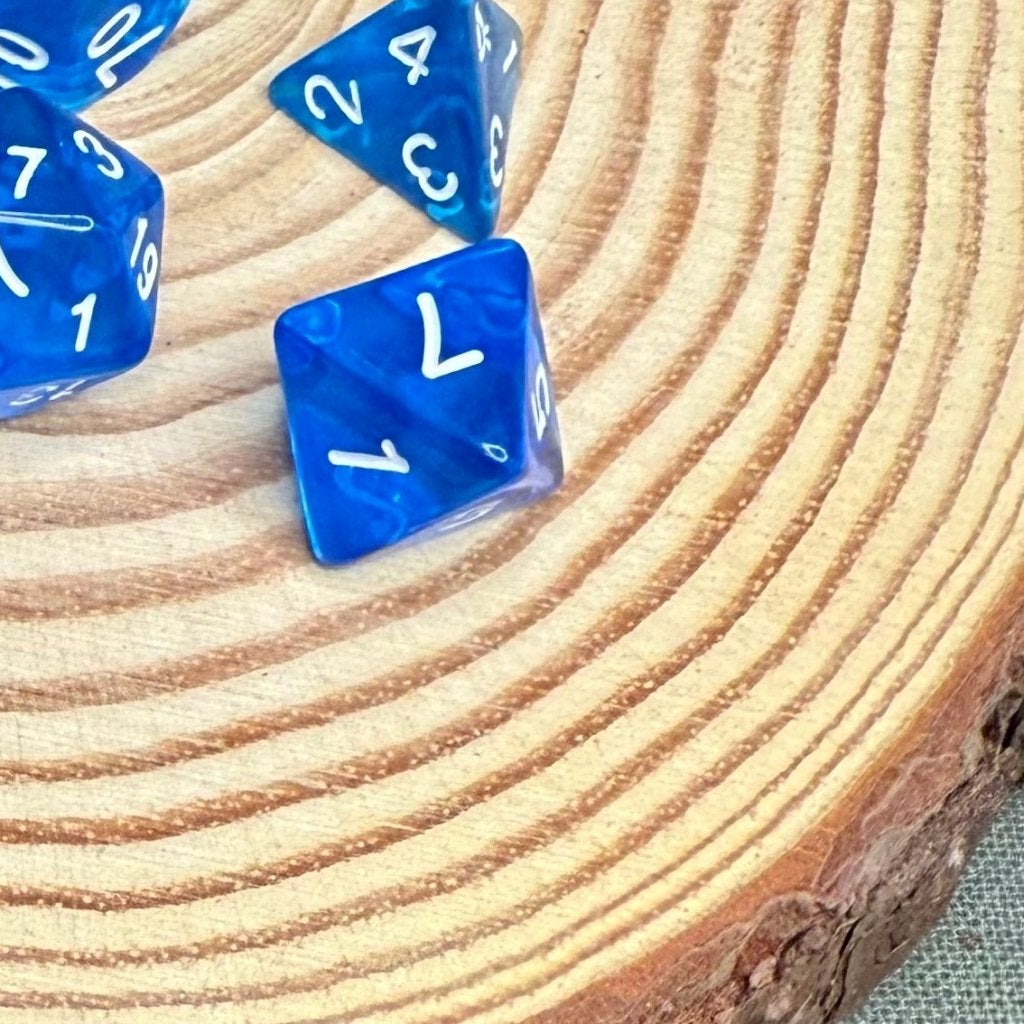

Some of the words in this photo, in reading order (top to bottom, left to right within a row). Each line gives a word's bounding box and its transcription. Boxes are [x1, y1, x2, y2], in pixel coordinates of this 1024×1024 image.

[87, 3, 165, 89] 70
[388, 25, 437, 86] 4
[304, 74, 364, 125] 2
[73, 129, 125, 180] 3
[402, 132, 459, 201] 3
[490, 114, 504, 188] 3
[71, 292, 97, 352] 1
[416, 291, 484, 380] 7
[328, 438, 410, 474] 1
